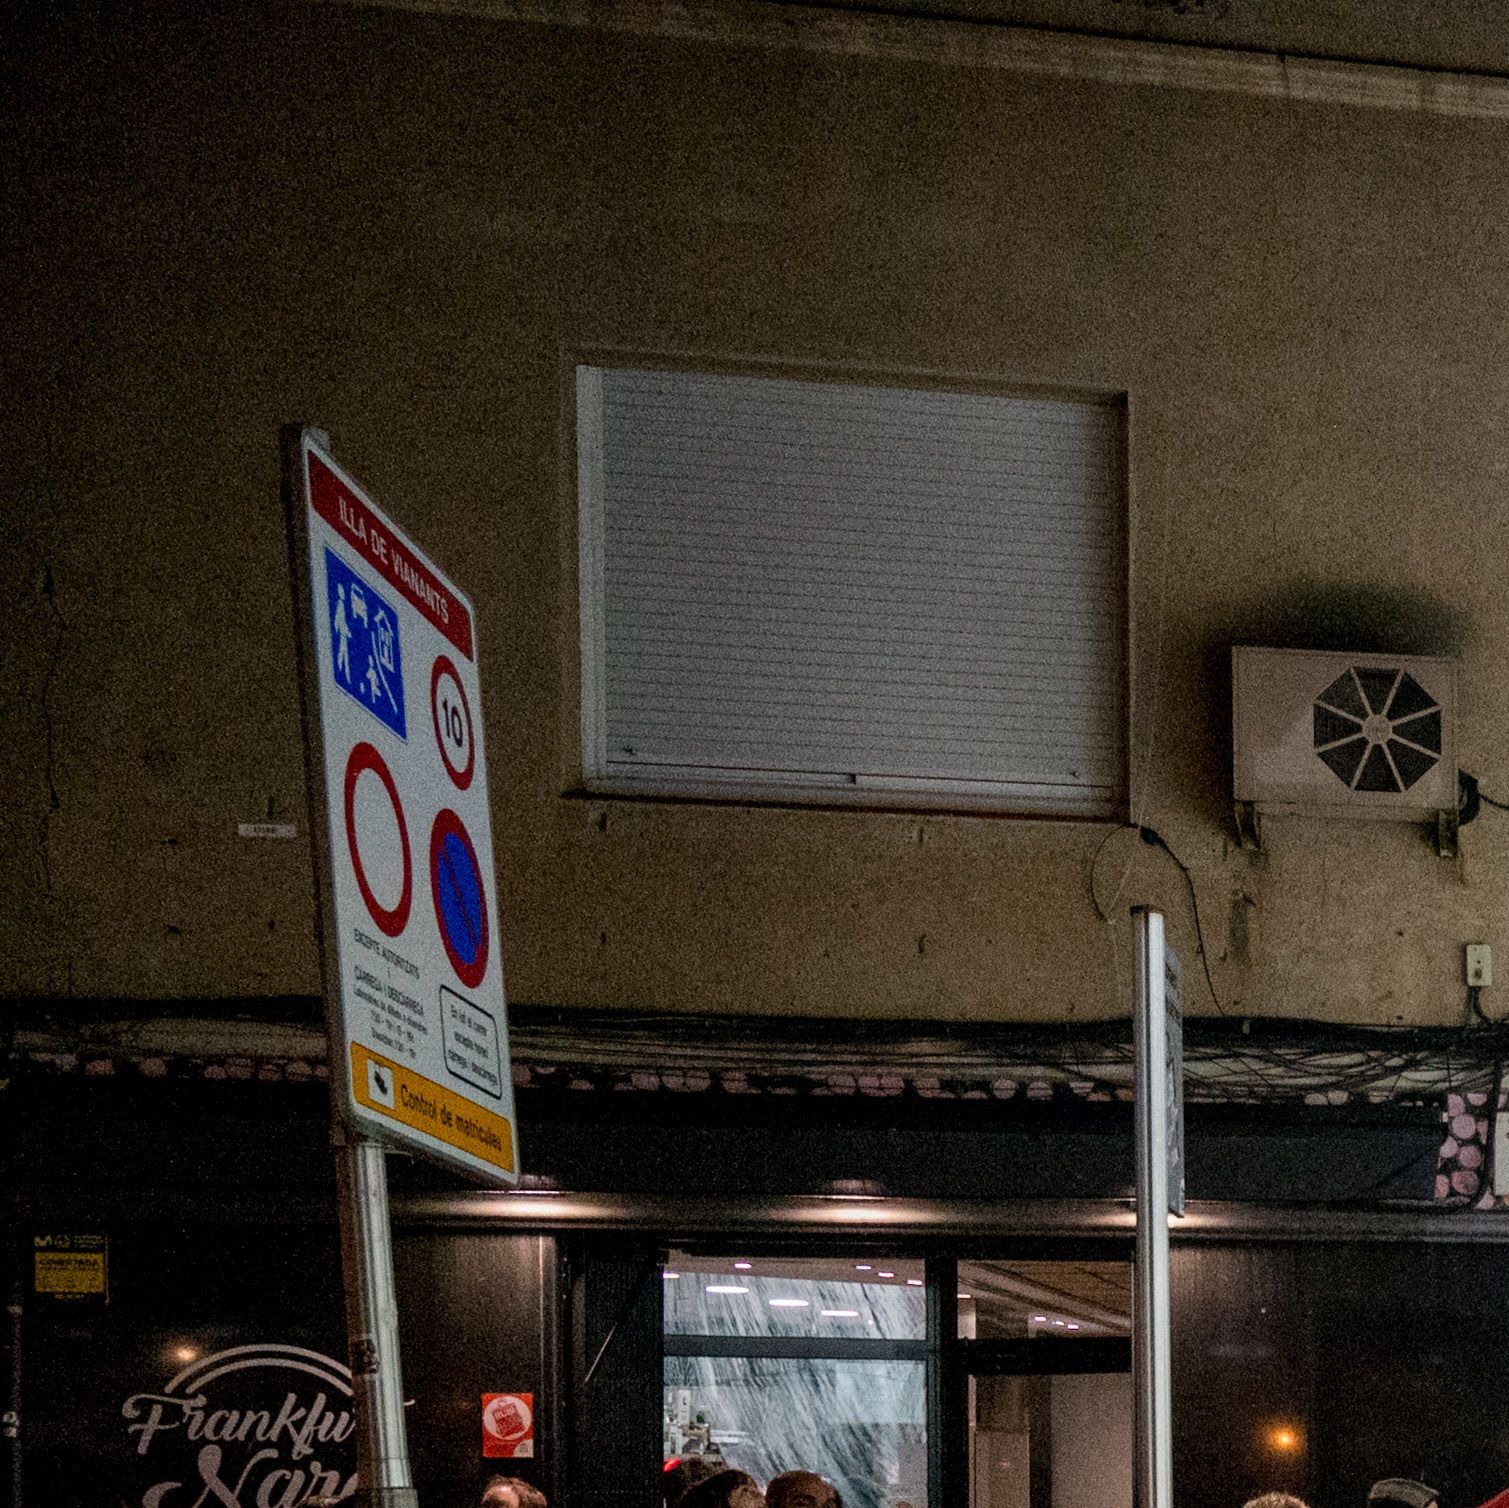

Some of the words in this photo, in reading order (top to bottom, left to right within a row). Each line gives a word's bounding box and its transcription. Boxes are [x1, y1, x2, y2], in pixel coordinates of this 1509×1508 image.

[338, 497, 366, 546] ILLA
[370, 528, 388, 566] DE
[391, 549, 449, 624] VIANANTS
[442, 698, 463, 748] 10
[400, 1084, 437, 1122] Control
[440, 1104, 453, 1128] de
[122, 1391, 356, 1460] Frankfu
